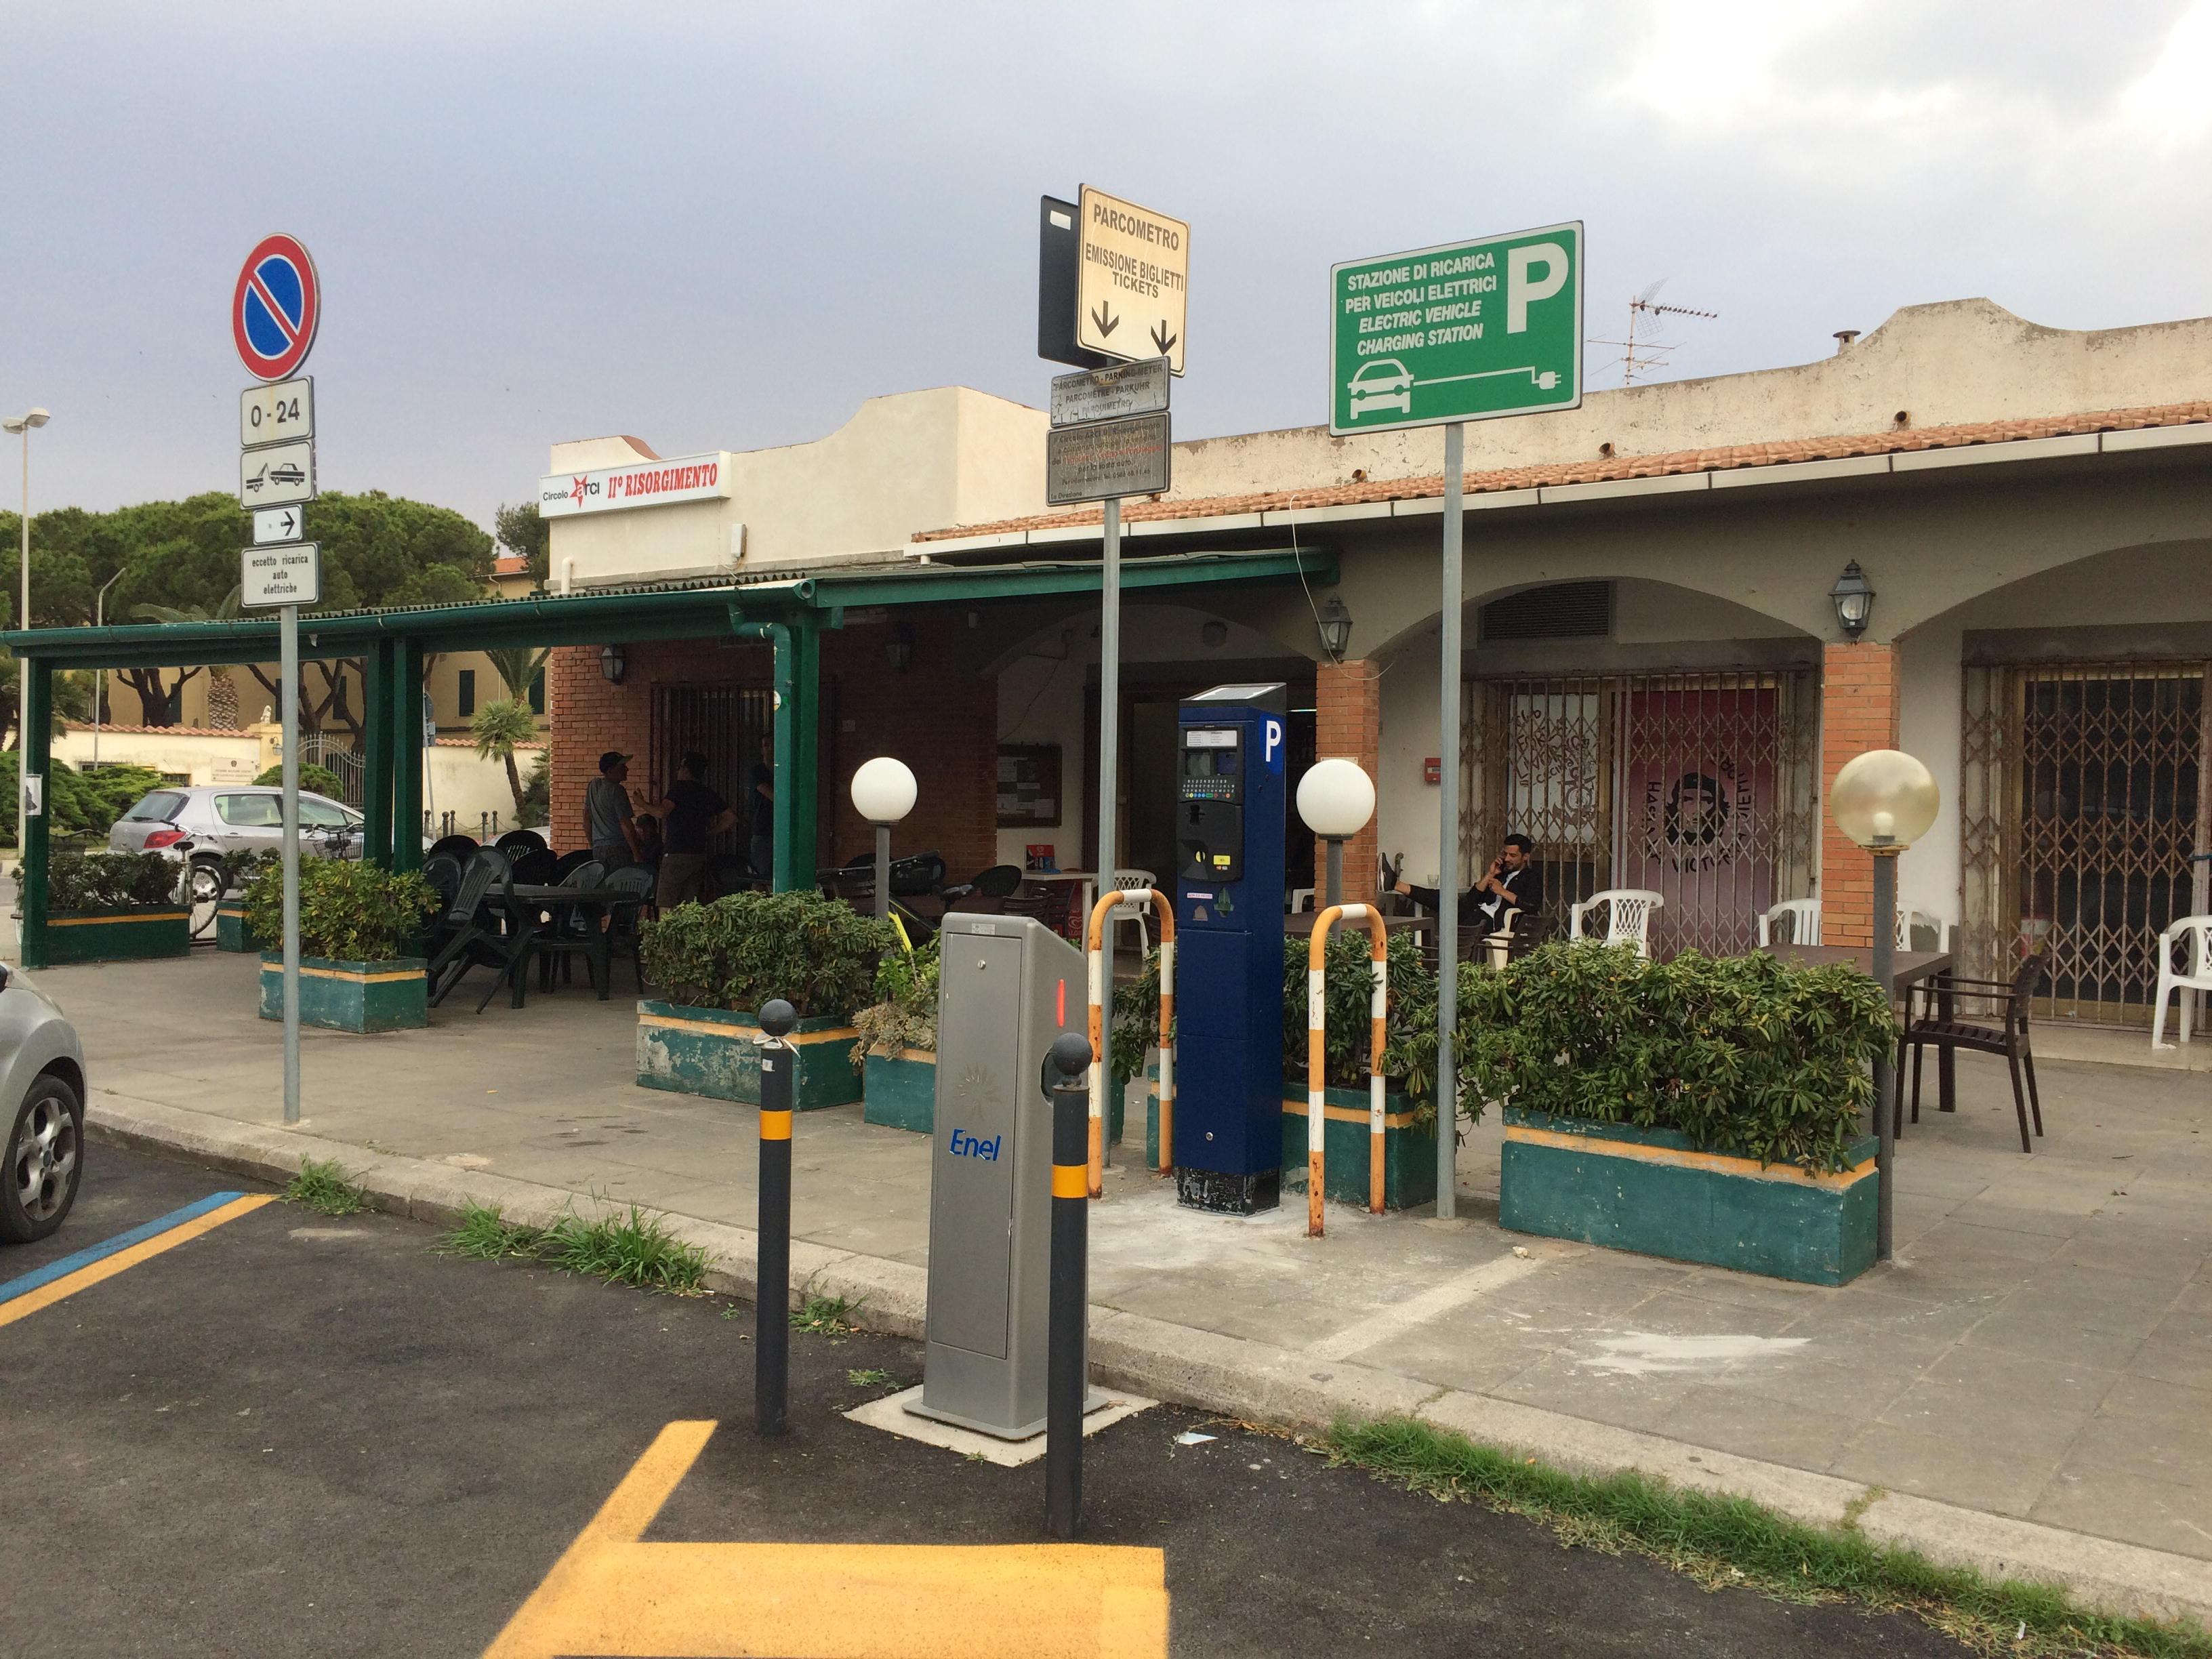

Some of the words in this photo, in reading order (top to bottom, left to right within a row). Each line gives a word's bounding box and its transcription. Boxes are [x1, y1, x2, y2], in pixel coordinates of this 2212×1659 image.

[1093, 203, 1179, 251] PARCOMETRO
[1086, 242, 1137, 276] EMISSIONE
[1140, 261, 1184, 292] BIGLIETTI
[1112, 271, 1159, 299] TICKETS
[1348, 266, 1410, 291] STAZIONE
[1414, 264, 1427, 281] DI
[1431, 252, 1496, 277] RICARICA
[1345, 296, 1371, 314] PER
[1374, 289, 1424, 307] VEICOLI
[1428, 275, 1497, 300] ELETTRICI
[1507, 243, 1570, 334] P
[1359, 310, 1422, 333] ELECTRIC
[1425, 300, 1482, 324] VEHICLE
[1357, 332, 1425, 356] CHARGING
[1427, 323, 1484, 346] STATION
[543, 490, 569, 501] Circolo
[625, 462, 718, 497] RISORGIMENTO
[251, 556, 276, 567] eccetto
[282, 554, 308, 565] ricarica
[272, 569, 288, 579] auto
[264, 583, 297, 594] elettriche
[1265, 720, 1282, 762] P
[949, 1128, 1002, 1162] Enel
